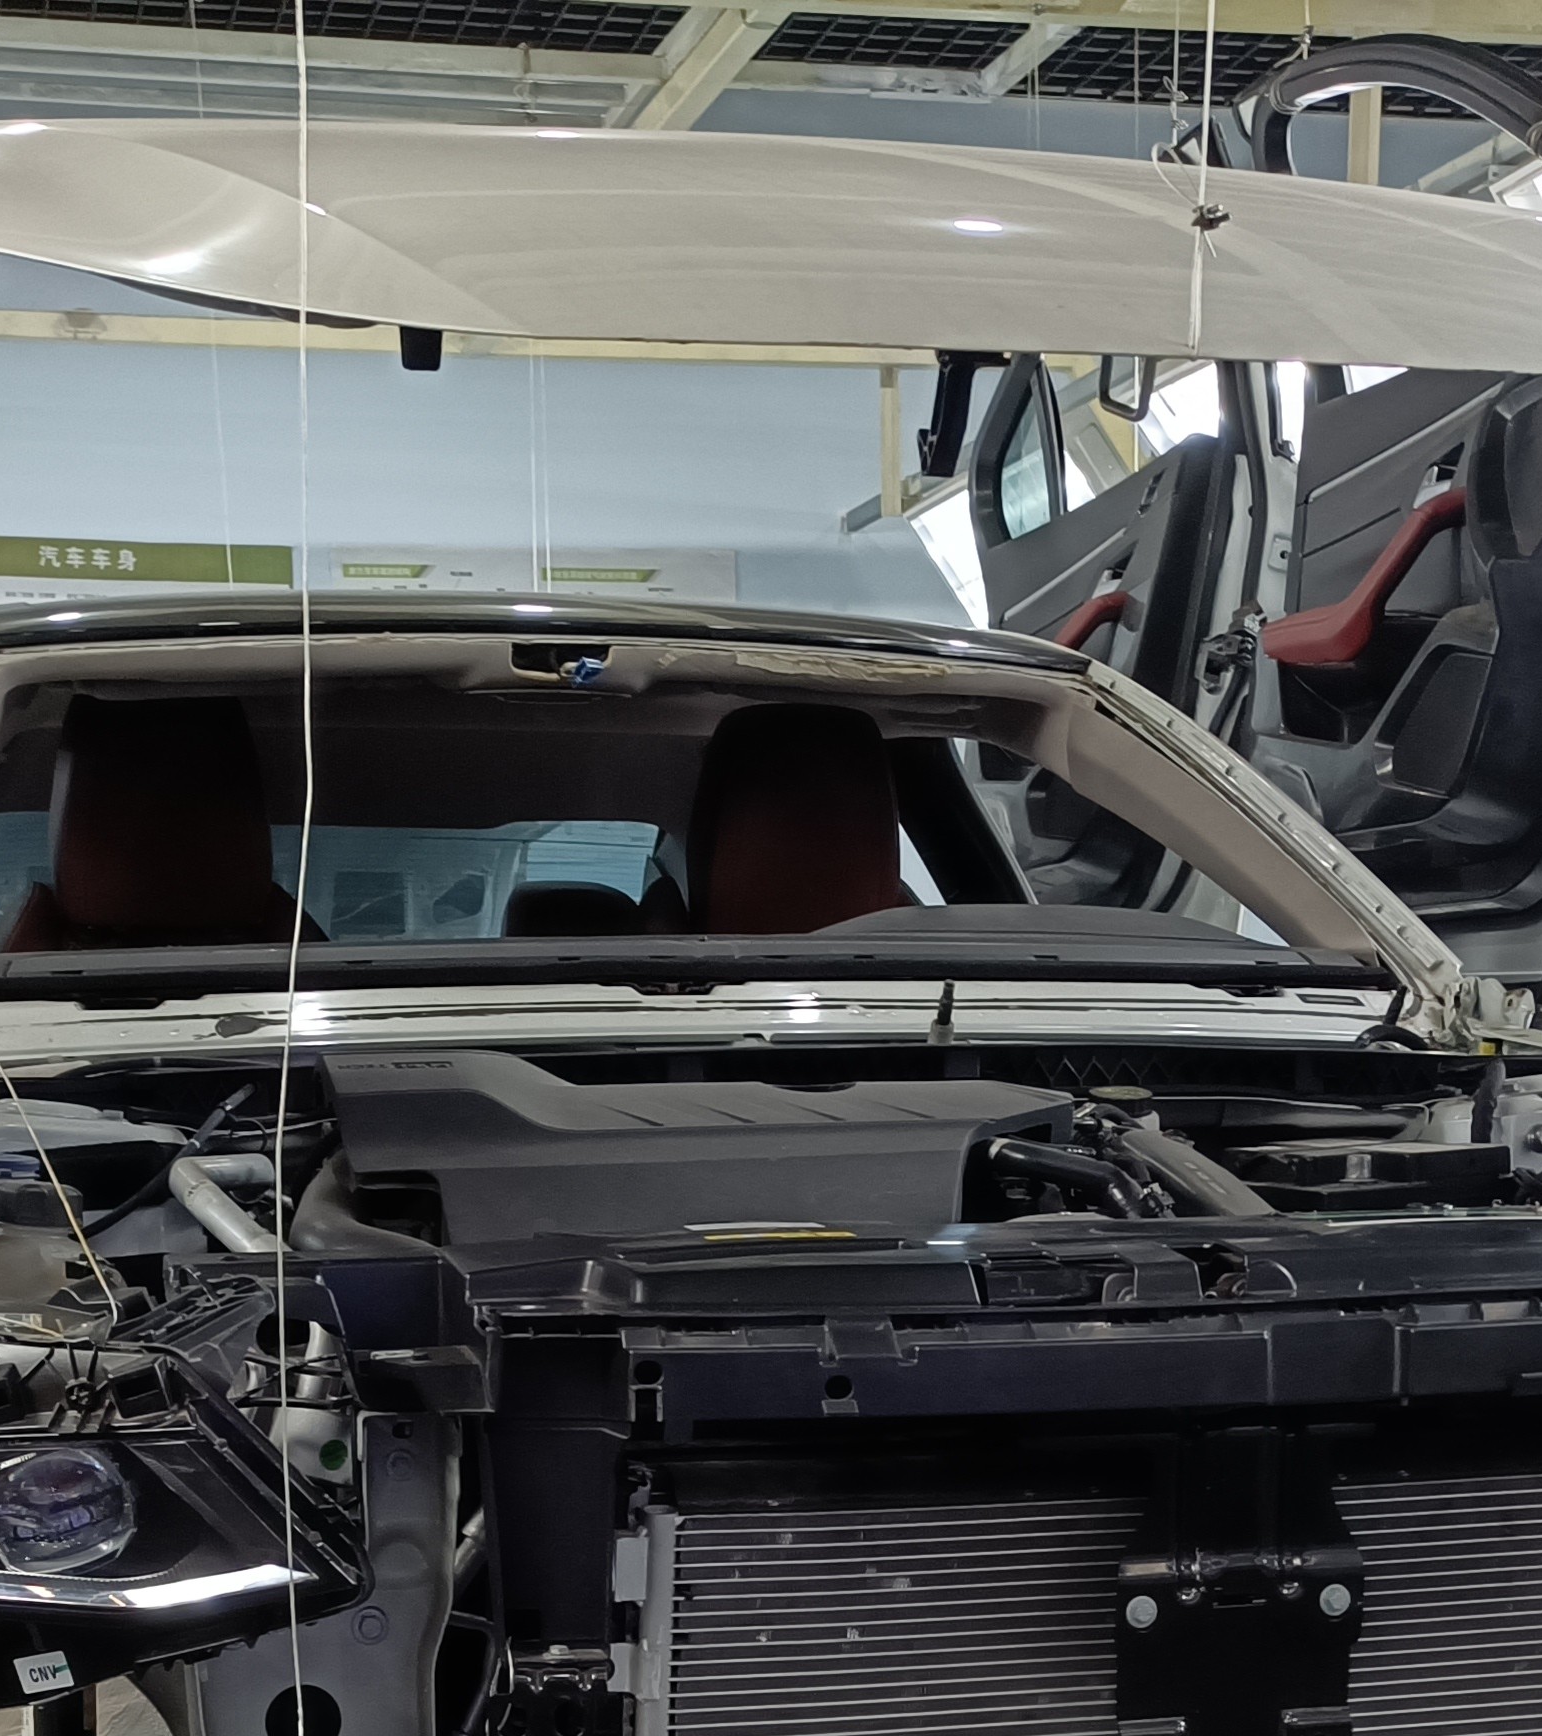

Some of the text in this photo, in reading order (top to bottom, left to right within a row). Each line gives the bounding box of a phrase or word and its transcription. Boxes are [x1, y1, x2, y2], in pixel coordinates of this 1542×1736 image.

[39, 545, 137, 572] 汽车车身
[28, 1664, 58, 1683] CNV
